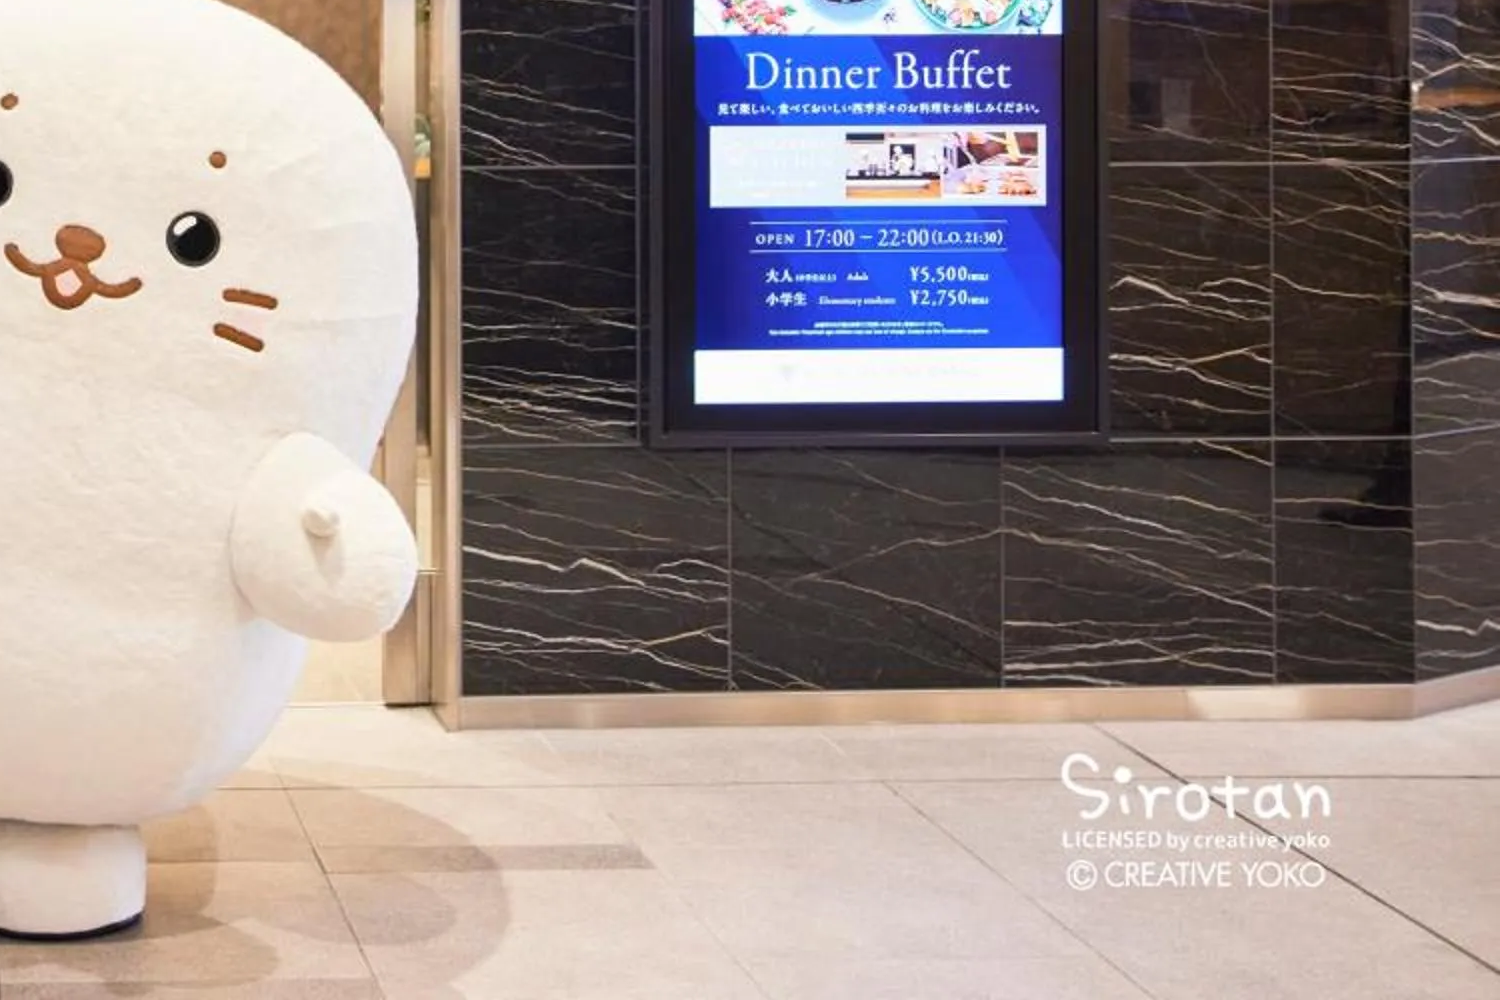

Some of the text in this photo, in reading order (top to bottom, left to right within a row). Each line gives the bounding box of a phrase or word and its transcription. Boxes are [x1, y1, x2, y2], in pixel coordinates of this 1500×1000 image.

[746, 48, 1013, 90] Dinner Buffet
[755, 233, 795, 245] OPEN
[805, 228, 855, 248] 17:00
[765, 291, 808, 307] 小学生
